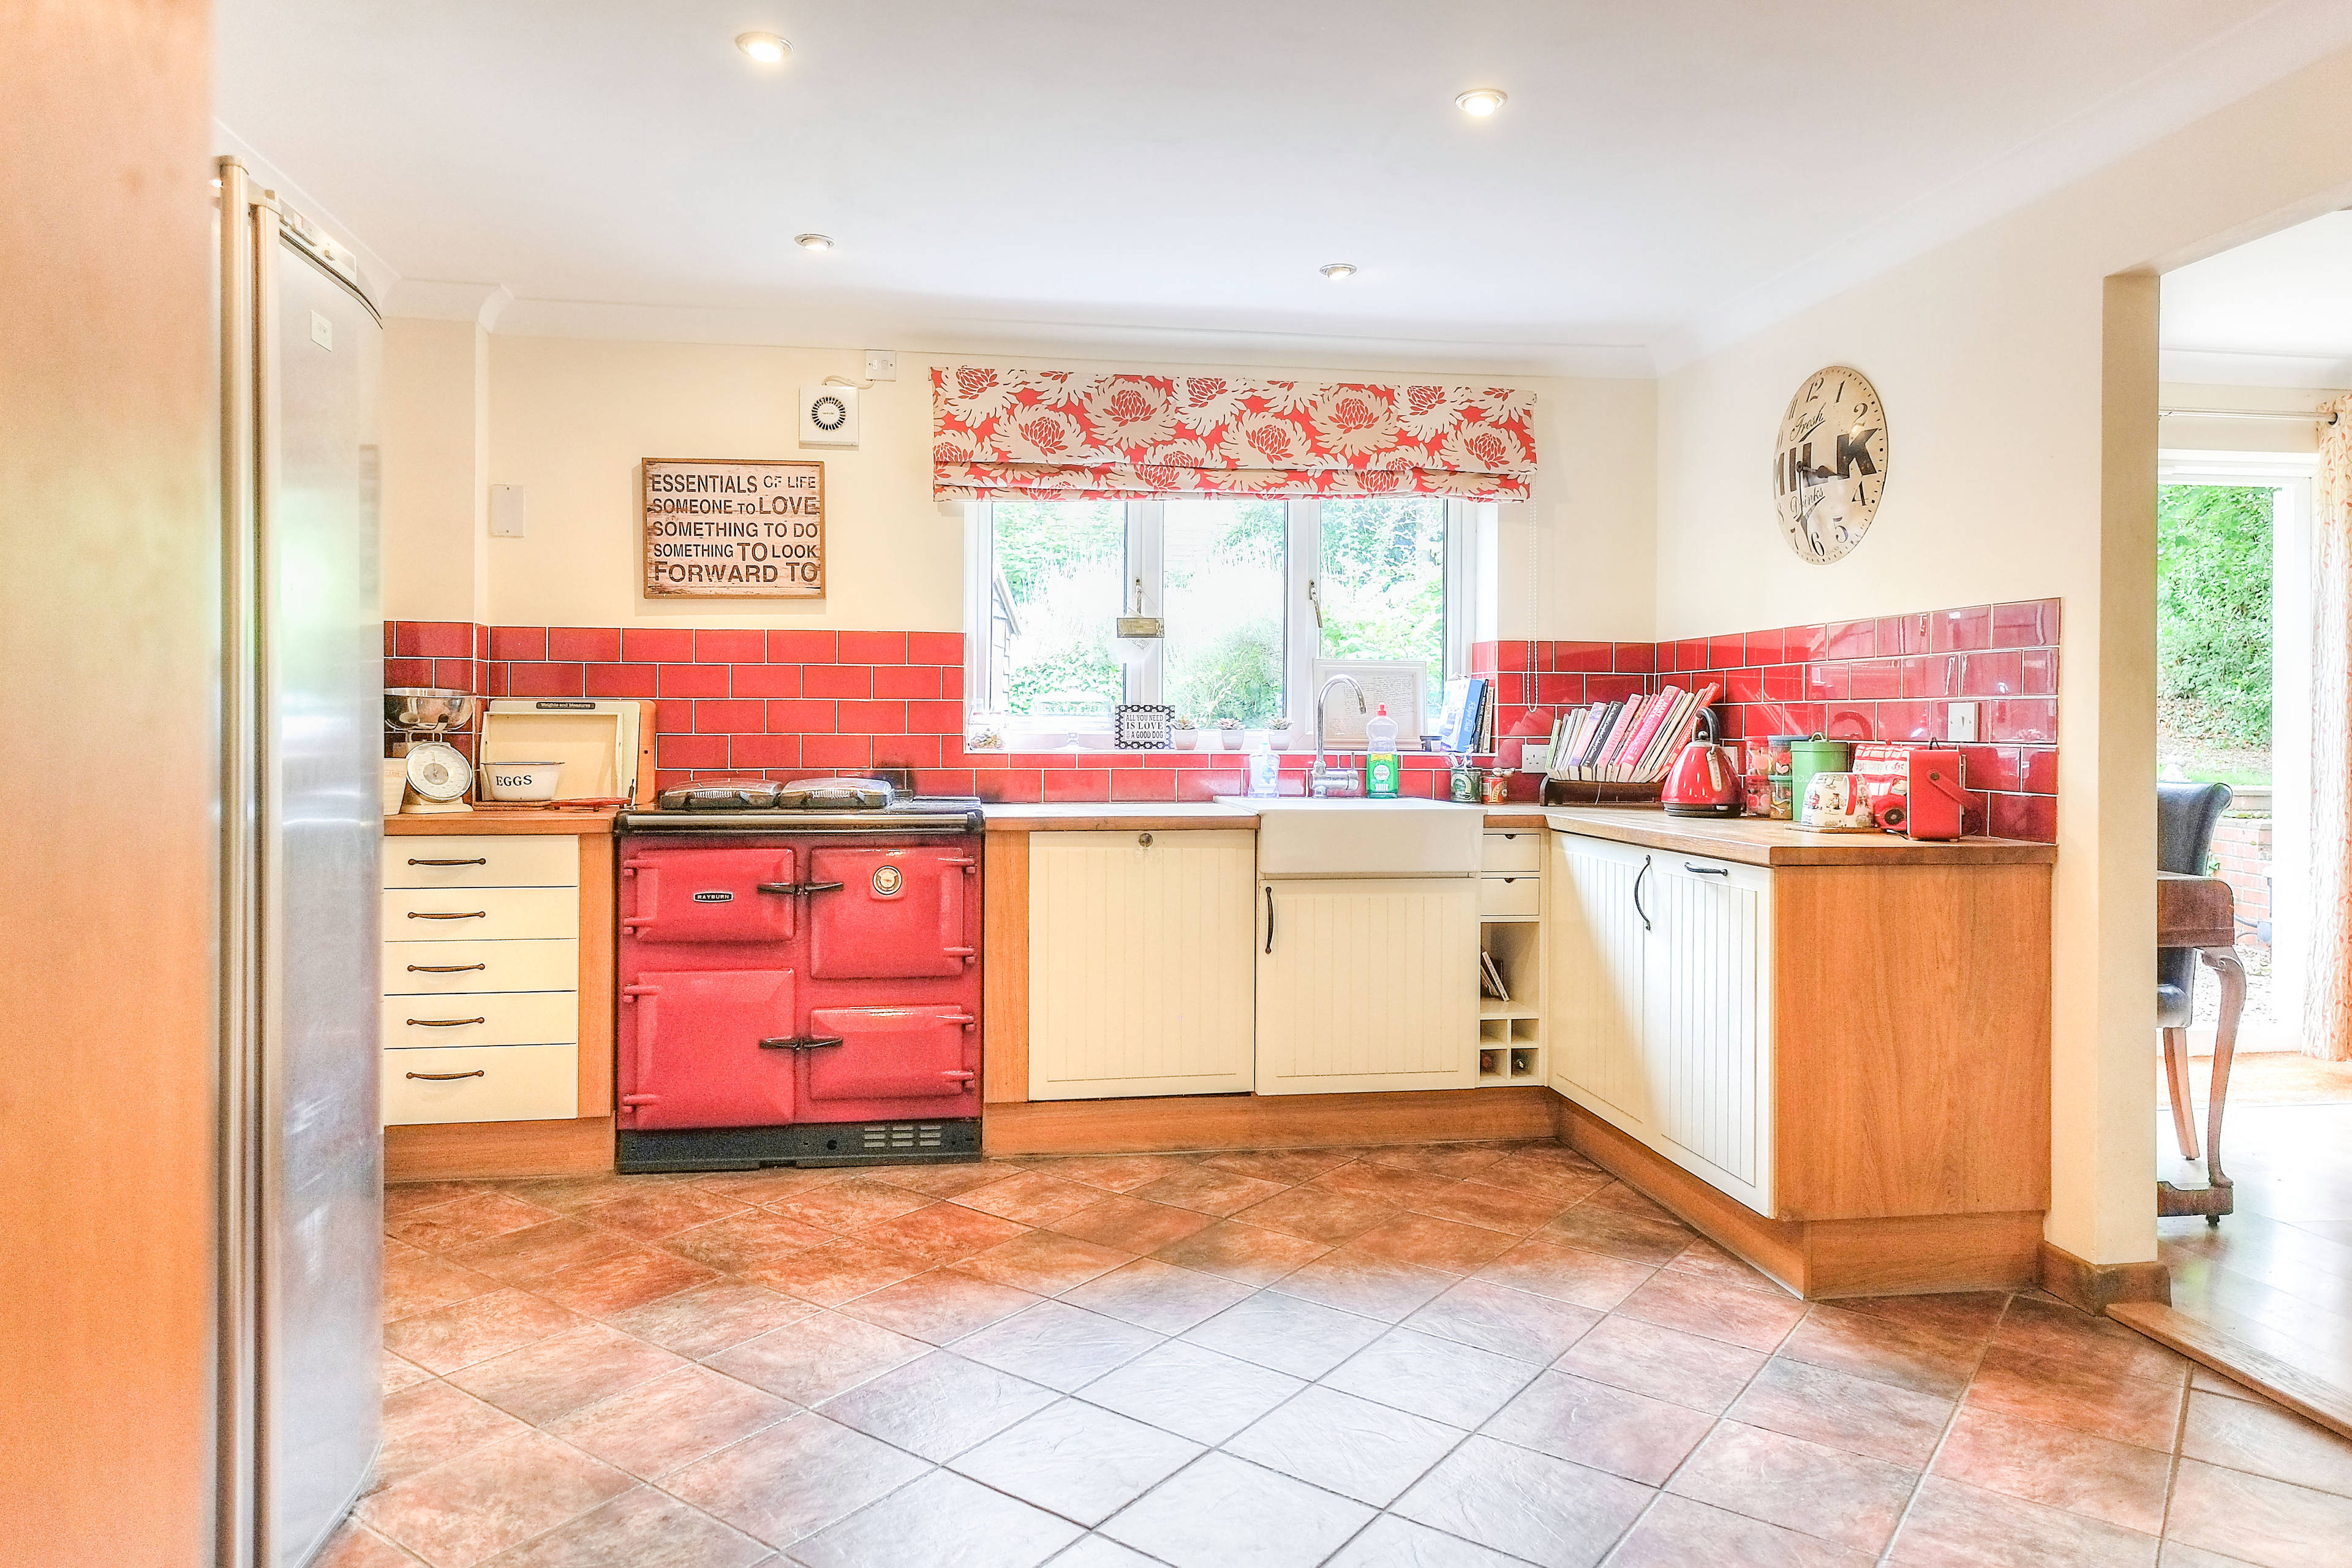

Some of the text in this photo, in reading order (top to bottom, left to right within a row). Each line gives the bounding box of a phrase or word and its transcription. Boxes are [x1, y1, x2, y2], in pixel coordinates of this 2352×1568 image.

[1806, 378, 1824, 403] 12
[1836, 380, 1845, 403] 1
[1790, 402, 1826, 442] Fresh
[1853, 403, 1868, 426] 2
[1774, 428, 1879, 500] MILK
[652, 474, 757, 493] ESSENTIALS
[788, 477, 815, 488] LIFE
[1852, 481, 1868, 506] 4
[652, 496, 818, 514] SOMEONE TO LOVE
[652, 521, 818, 538] SOMETHING TO DO
[1833, 516, 1848, 543] 5
[654, 543, 816, 562] SOMETHING TO LOOK
[1811, 532, 1824, 556] 6
[655, 562, 818, 582] FORWARD TO
[1655, 701, 1668, 718] MARY
[496, 775, 532, 786] EGGS
